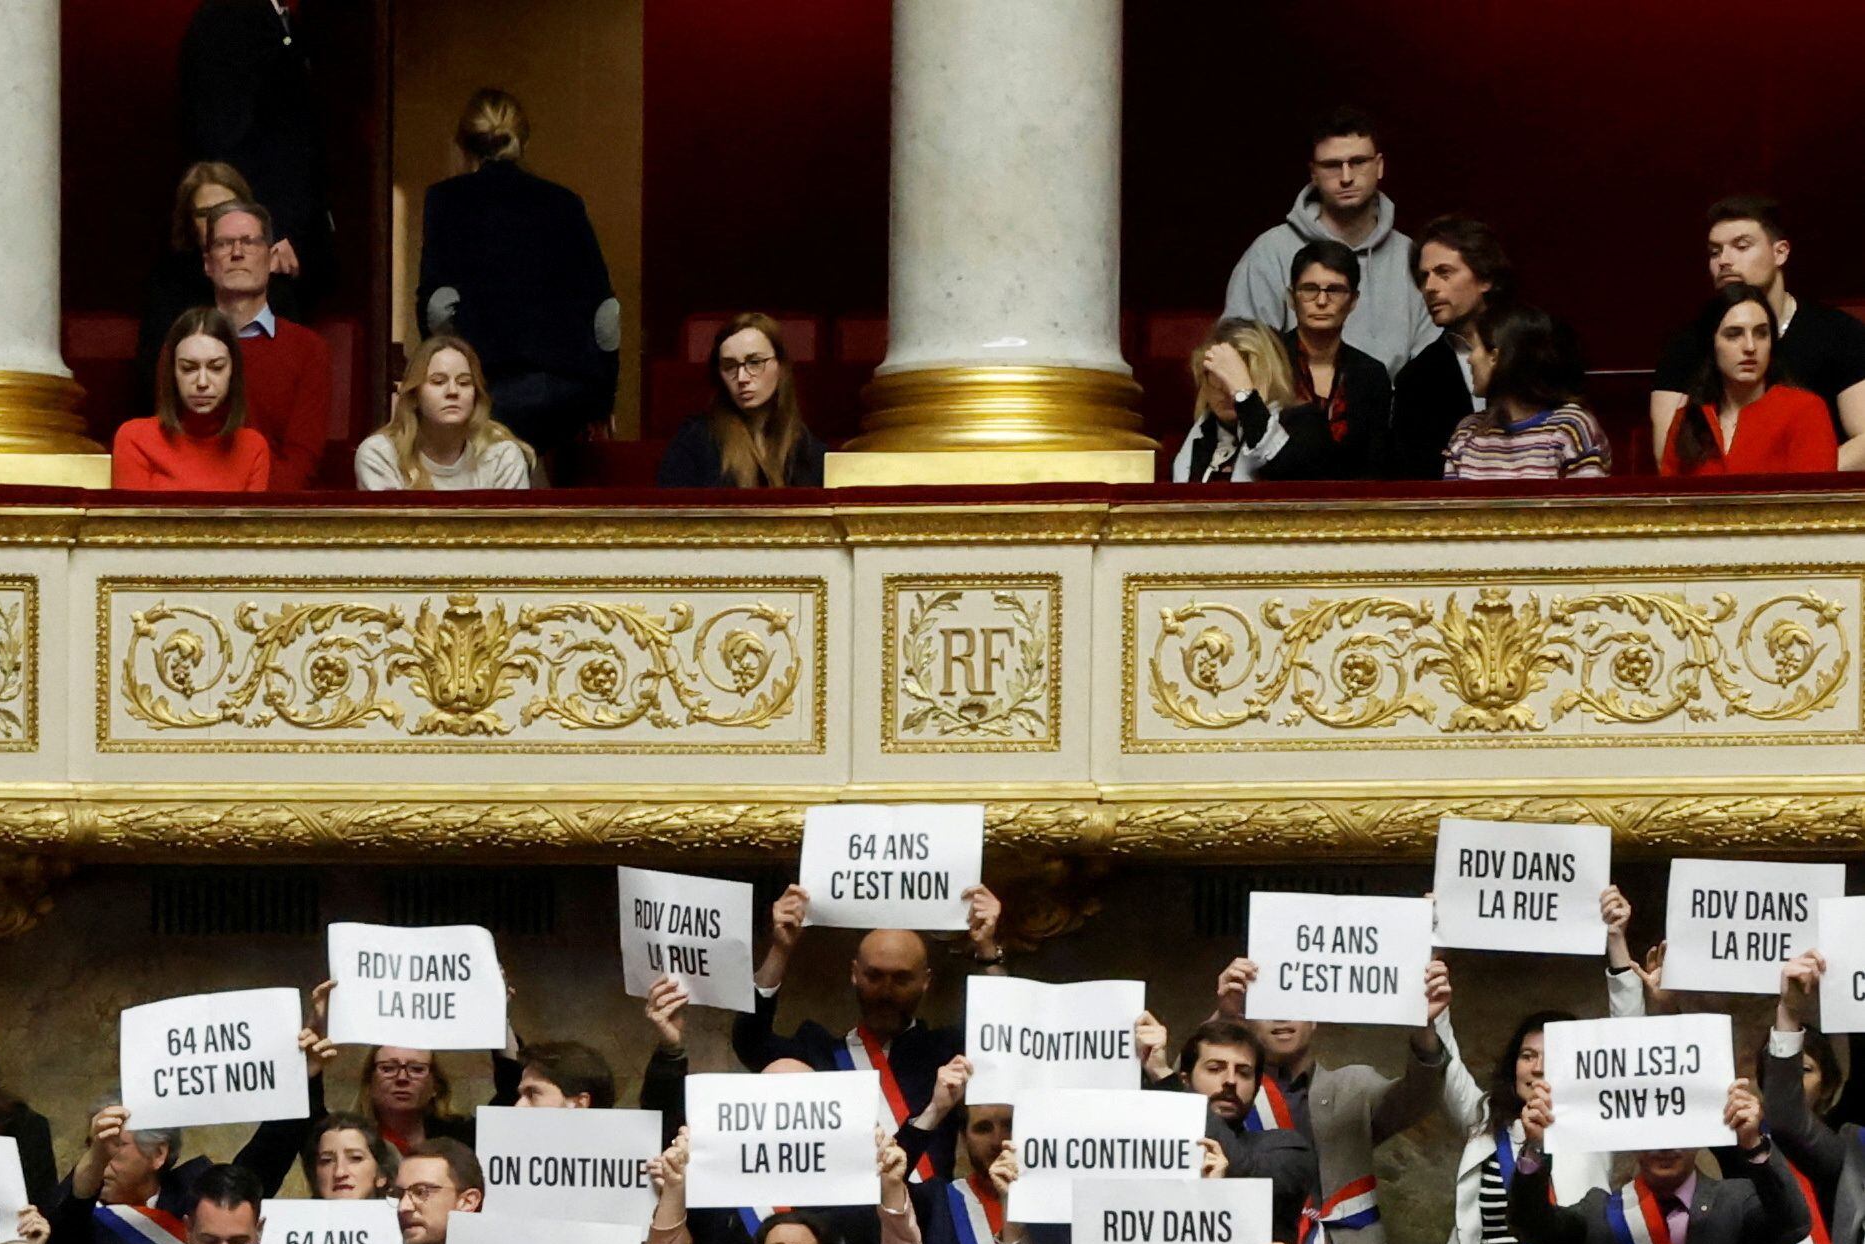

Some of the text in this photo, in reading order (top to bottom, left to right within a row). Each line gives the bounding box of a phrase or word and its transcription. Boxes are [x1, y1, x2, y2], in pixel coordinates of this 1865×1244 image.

[938, 626, 1015, 698] RF
[848, 832, 929, 861] 64 ANS
[1458, 848, 1576, 883] RDV DANS
[830, 870, 949, 901] C'EST NON
[633, 897, 721, 940] RDV DANS
[1478, 888, 1559, 922] LA RUE
[1691, 888, 1809, 923] RDV DANS
[1296, 924, 1379, 955] 64 ANS
[1711, 930, 1792, 963] LA RUE
[357, 950, 472, 982] RDV DANS
[647, 940, 711, 978] LA RUE
[1279, 961, 1399, 995] C'EST NON
[378, 989, 456, 1021] LA RUE
[167, 1021, 252, 1057] 64 ANS
[980, 1023, 1131, 1062] ON CONTINUE
[153, 1059, 276, 1098] C'EST NON
[1576, 1043, 1701, 1080] C'EST NON
[717, 1100, 842, 1132] RDV DANS
[1598, 1085, 1686, 1120] 64 ANS
[741, 1141, 827, 1174] LA RUE
[1023, 1137, 1191, 1170] ON CONTINUE
[488, 1155, 649, 1189] ON CONTINUE
[1103, 1209, 1233, 1243] RDV DANS
